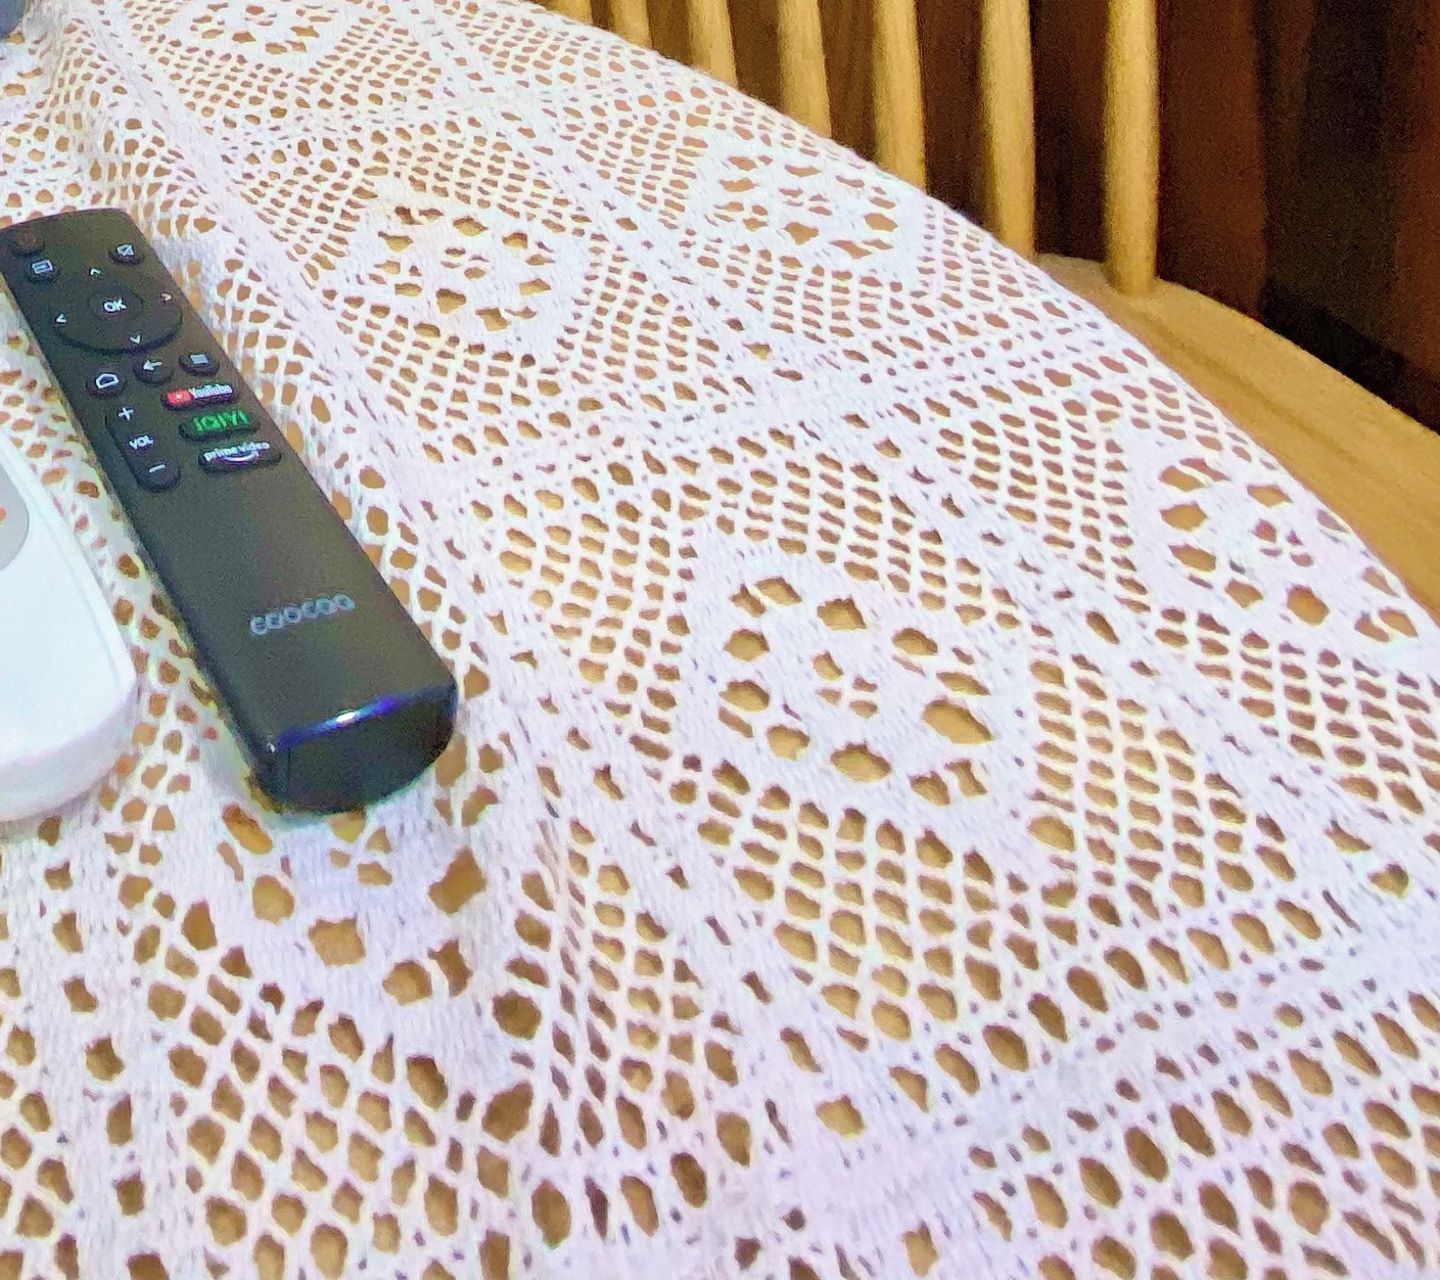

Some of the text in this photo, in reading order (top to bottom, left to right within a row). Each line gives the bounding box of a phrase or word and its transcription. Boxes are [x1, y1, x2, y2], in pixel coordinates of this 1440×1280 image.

[103, 298, 127, 312] OK
[188, 383, 233, 399] YouTube
[129, 434, 154, 450] VOL
[203, 441, 271, 462] prime video
